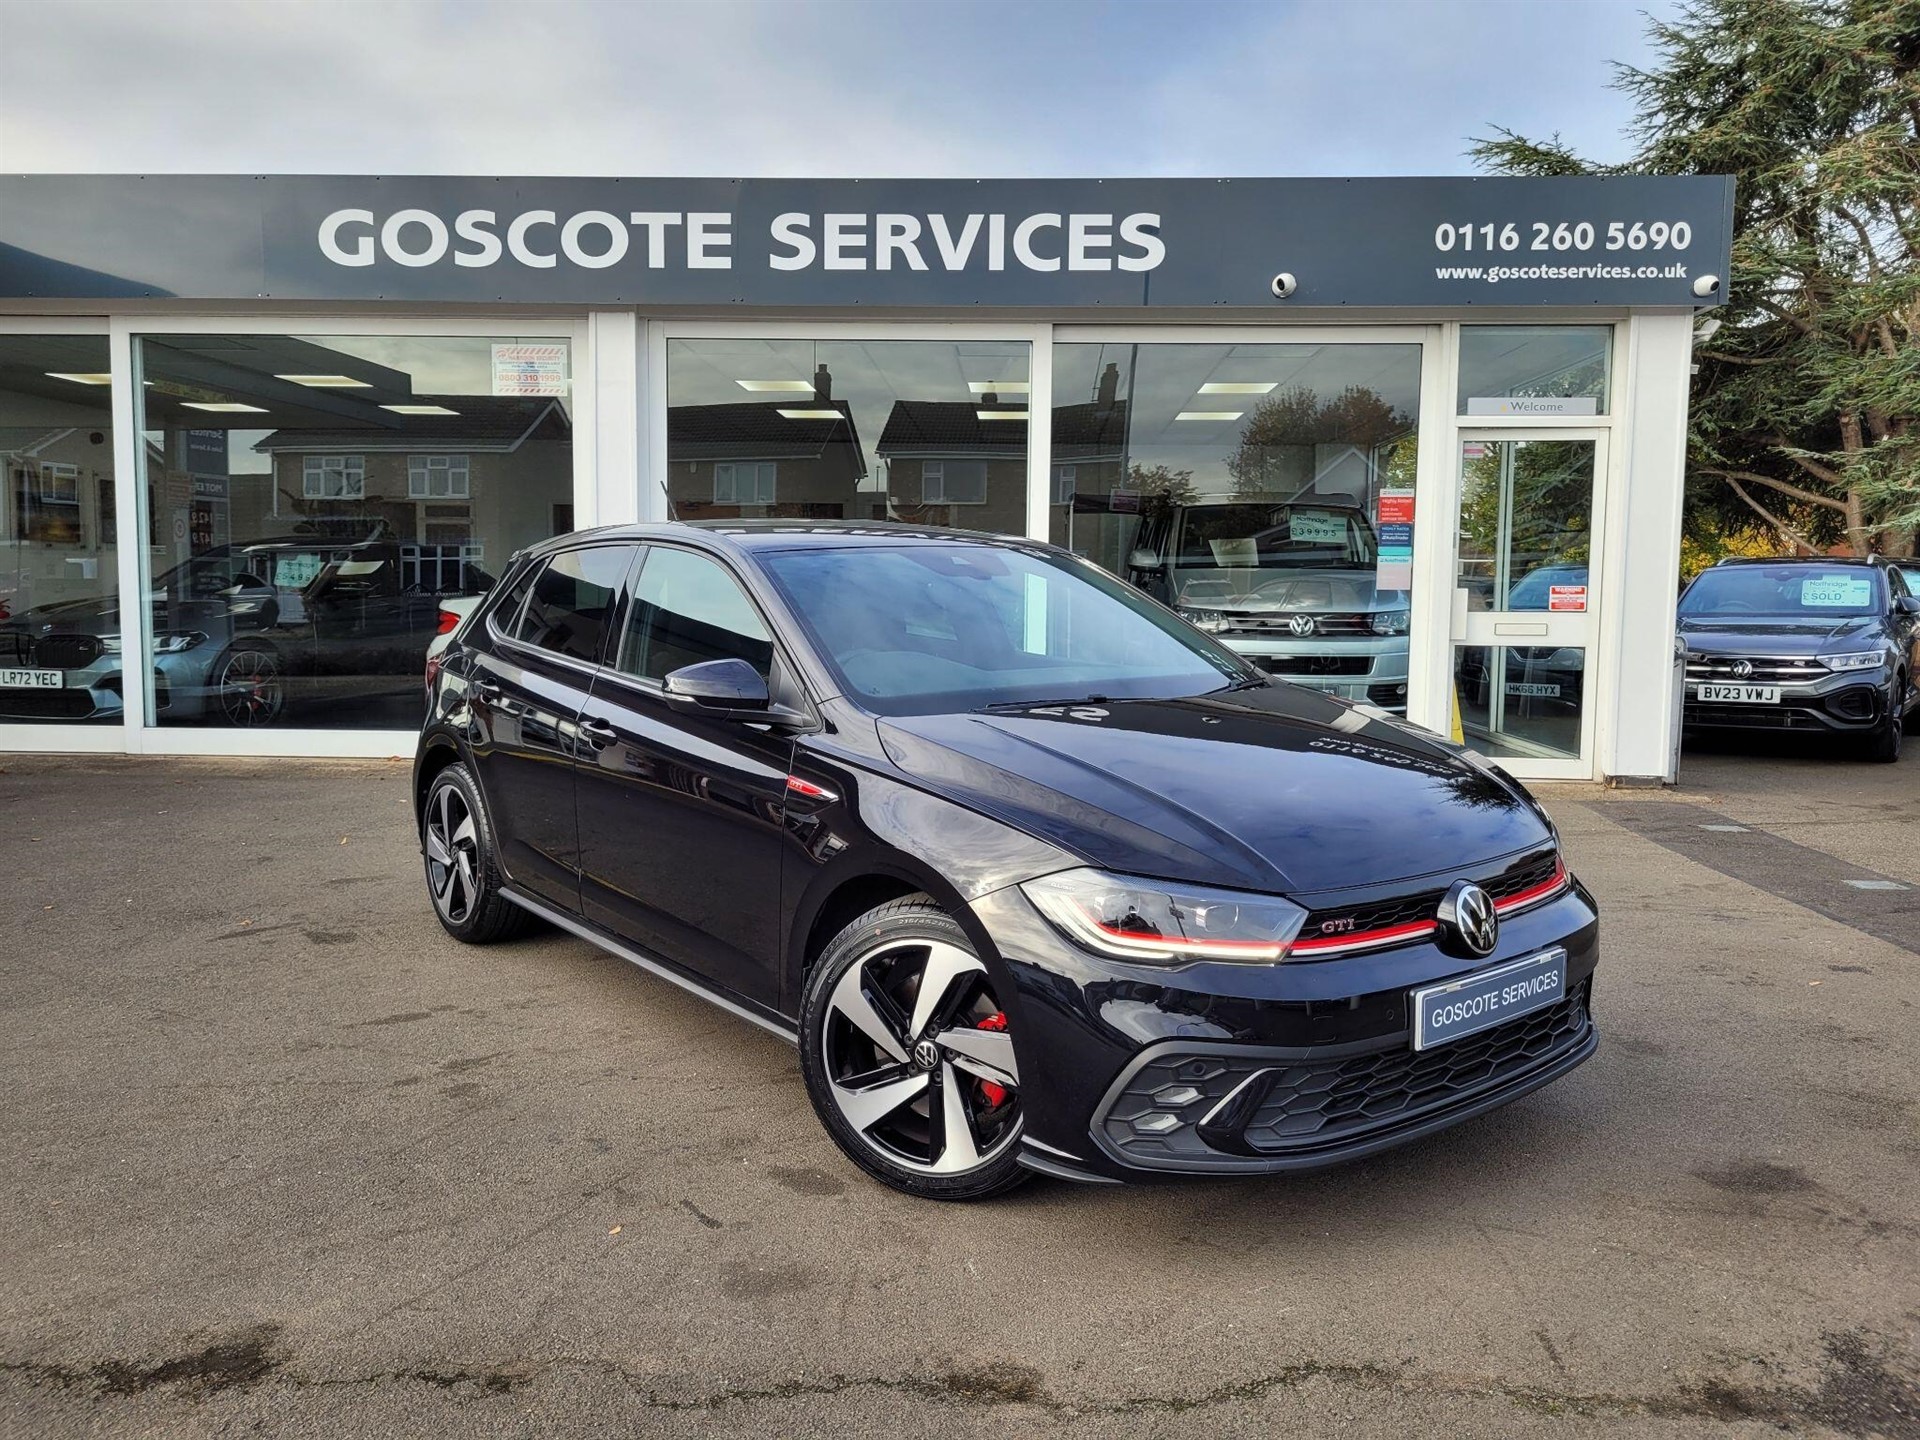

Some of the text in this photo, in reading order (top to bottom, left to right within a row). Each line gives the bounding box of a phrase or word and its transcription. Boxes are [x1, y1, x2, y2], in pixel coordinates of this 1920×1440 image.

[318, 208, 1166, 272] GOSCOTE SERVICES
[1435, 222, 1692, 251] 0116 260 5690
[1435, 263, 1687, 282] www.goscoteservices.co.uk
[498, 374, 561, 382] 0800 310 1999
[1510, 401, 1564, 412] Welcome
[1811, 592, 1842, 601] SOLD
[2, 671, 57, 686] LR72 YEC
[1536, 685, 1556, 695] HYX
[1703, 686, 1774, 701] BV23 VWJ
[1321, 918, 1355, 933] GTI
[1431, 970, 1558, 1028] GOSCOTE SERVICES
